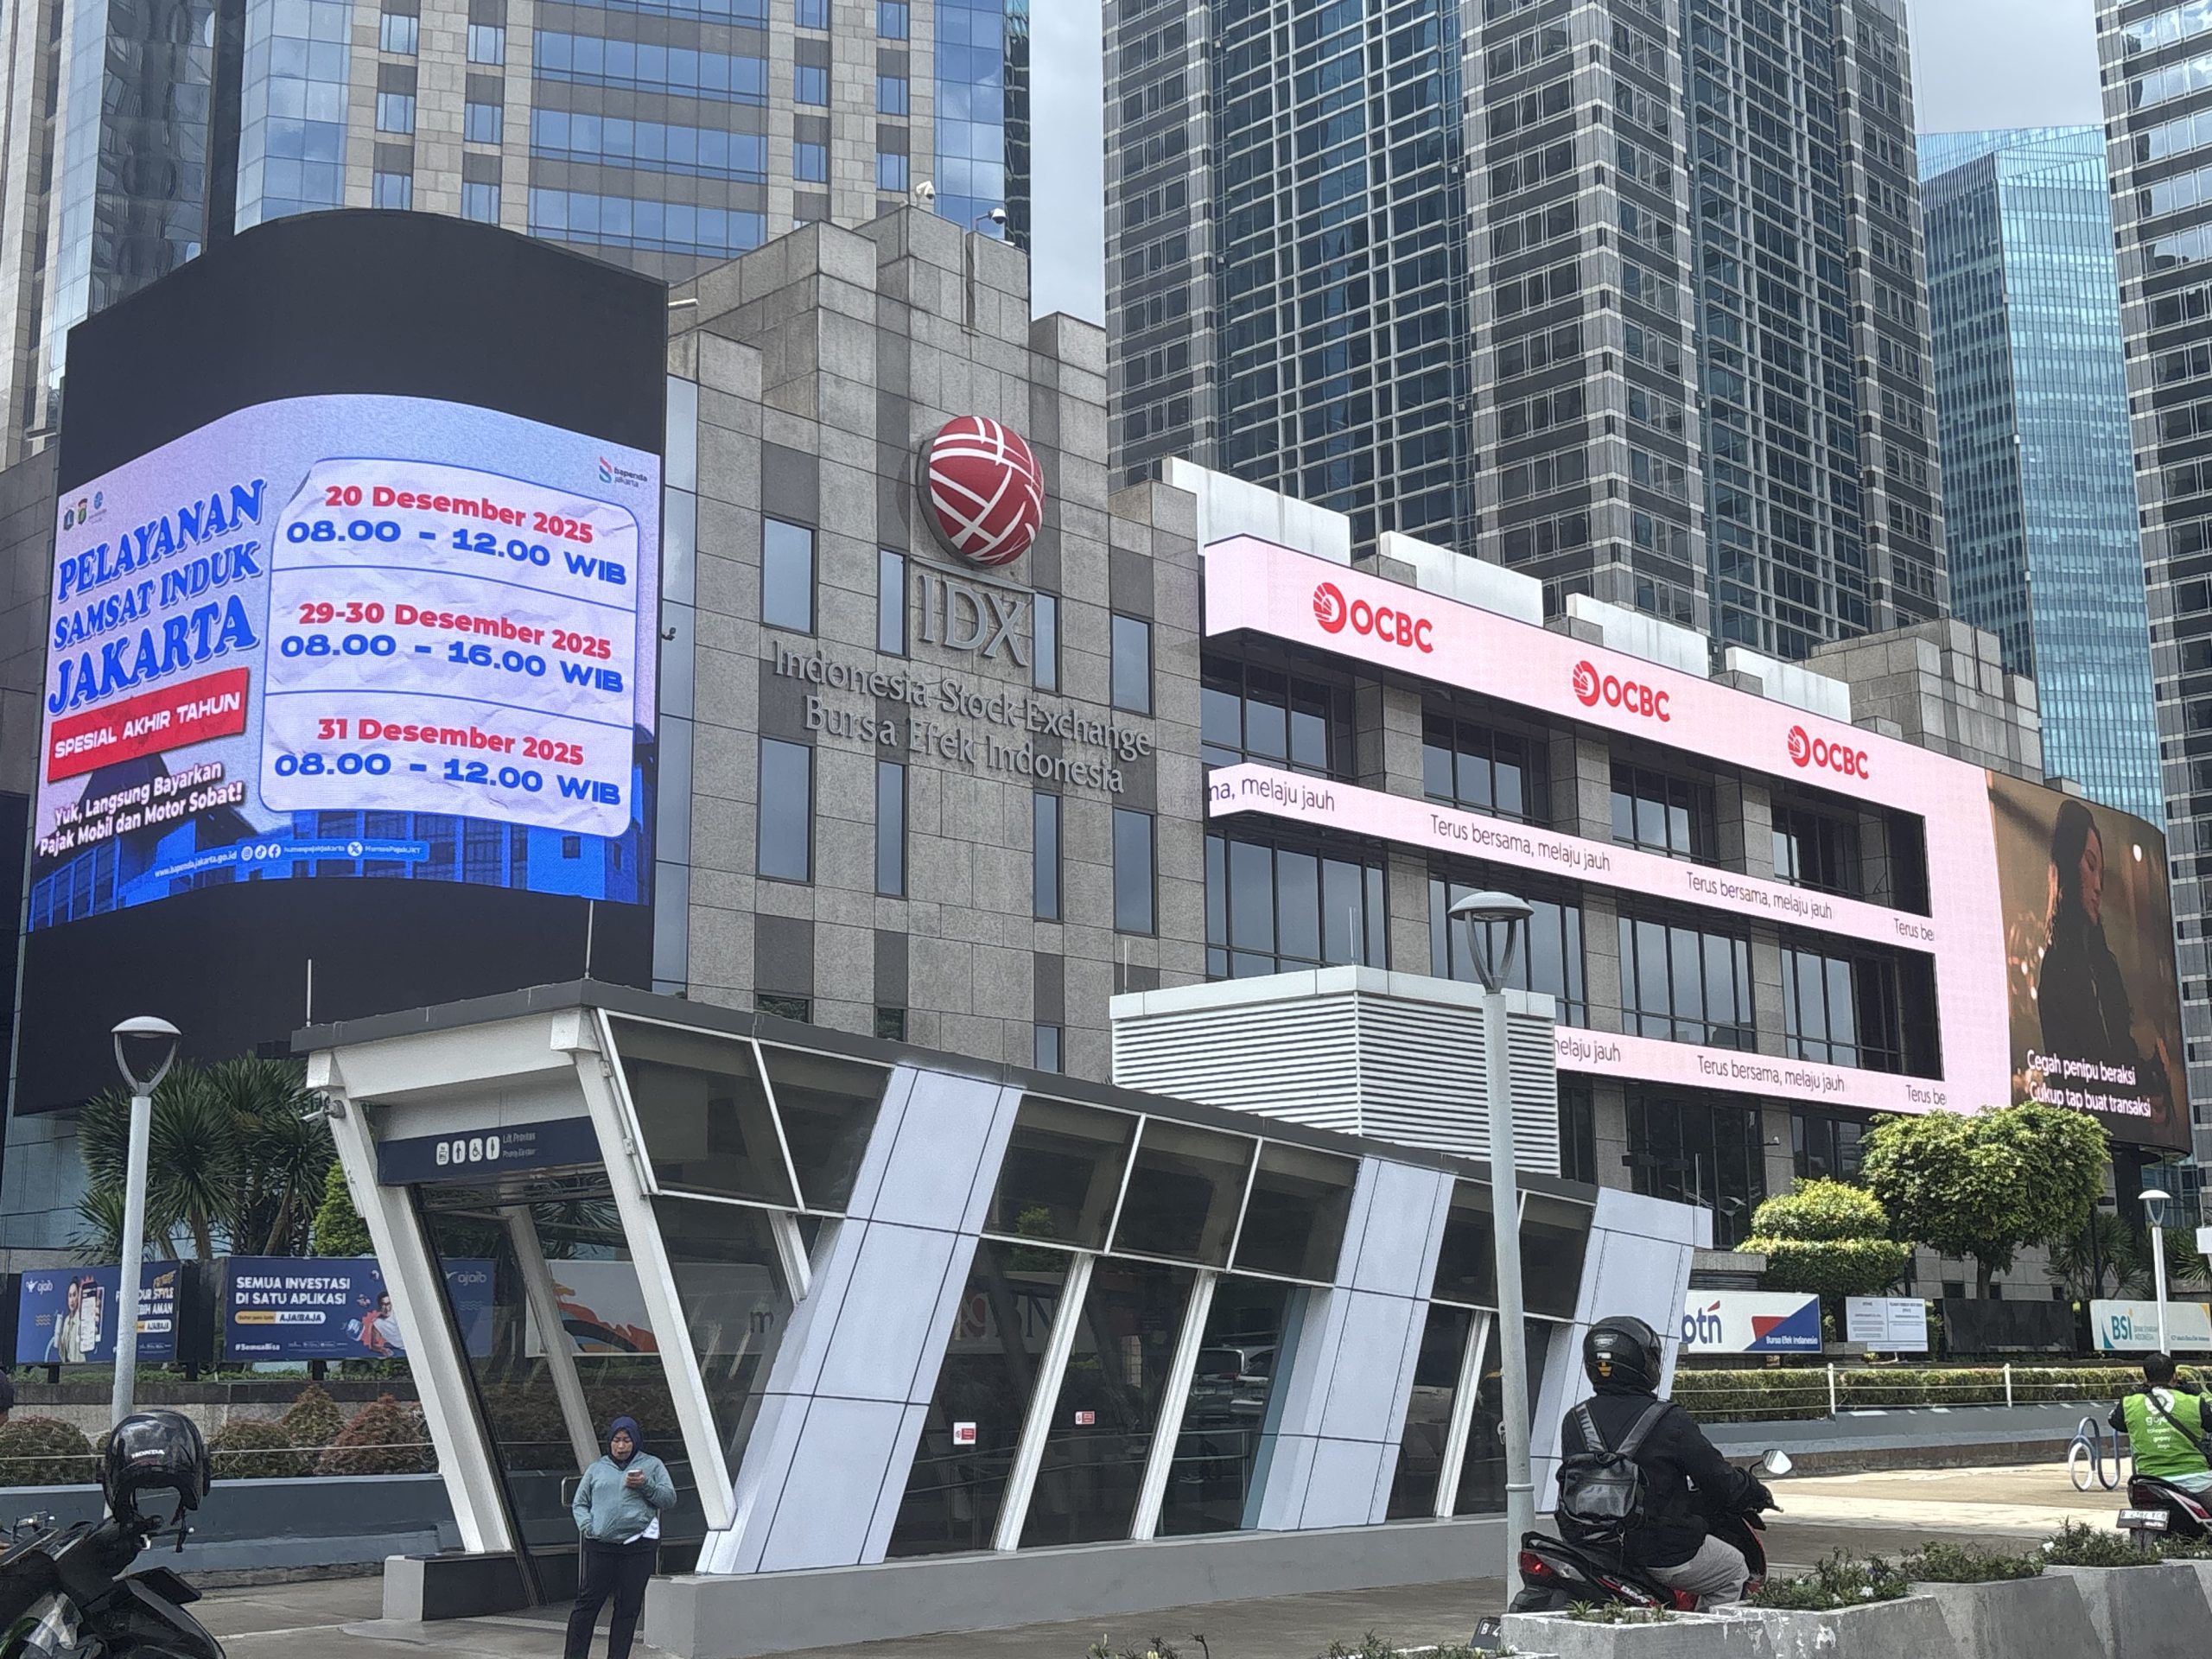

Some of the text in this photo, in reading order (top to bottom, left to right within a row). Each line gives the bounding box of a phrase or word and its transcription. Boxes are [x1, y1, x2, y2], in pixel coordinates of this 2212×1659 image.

[57, 479, 266, 601] PELAYANAN
[324, 486, 594, 543] 20 Desember 2025
[286, 520, 401, 543] 08.00
[452, 529, 551, 566] 12.00
[563, 551, 627, 585] WIB
[54, 541, 262, 649] SAMSAT INDUK
[918, 574, 1030, 667] IDX
[299, 602, 612, 660] 29-30 Desember 2025
[1351, 599, 1434, 654] OCBC
[48, 594, 258, 715] JAKARTA
[281, 634, 397, 658] 08.00
[448, 641, 547, 677] 16.00
[560, 660, 624, 692] WIB
[54, 691, 241, 759] SPESIAL AKHIR TAHUN
[773, 640, 1153, 762] Indonesia Stock Exchange
[1603, 675, 1671, 722] OCBC
[317, 719, 584, 766] 31 Desember 2025
[803, 695, 1126, 794] Bursa Efek Indonesia
[1813, 737, 1869, 779] OCBC
[54, 761, 222, 827] Yuk, Langsung Bayarkan
[274, 753, 391, 777] 08.00
[443, 760, 543, 792] 12.00
[556, 775, 621, 805] WIB
[1242, 778, 1297, 806] melaju
[1301, 785, 1335, 811] jauh
[40, 781, 243, 857] Pajak Mobil dan Motor Sobat!
[1430, 814, 1611, 872] Terus bersama, melaju jauh
[1687, 871, 1832, 920] Terus bersama, melaju jauh
[1893, 918, 1918, 938] Terus
[1593, 1042, 1621, 1064] jauh
[1697, 1055, 1845, 1094] Terus bersama, melaju jauh
[2027, 1049, 2136, 1085] Cegah penipu beraksi
[1905, 1084, 1931, 1104] Terus
[2030, 1081, 2152, 1117] Cukup tap buat transaksi
[235, 1292, 346, 1305] DI SATU APLIKASI
[236, 1276, 351, 1290] SEMUA INVESTASI
[2111, 1315, 2133, 1340] BSI
